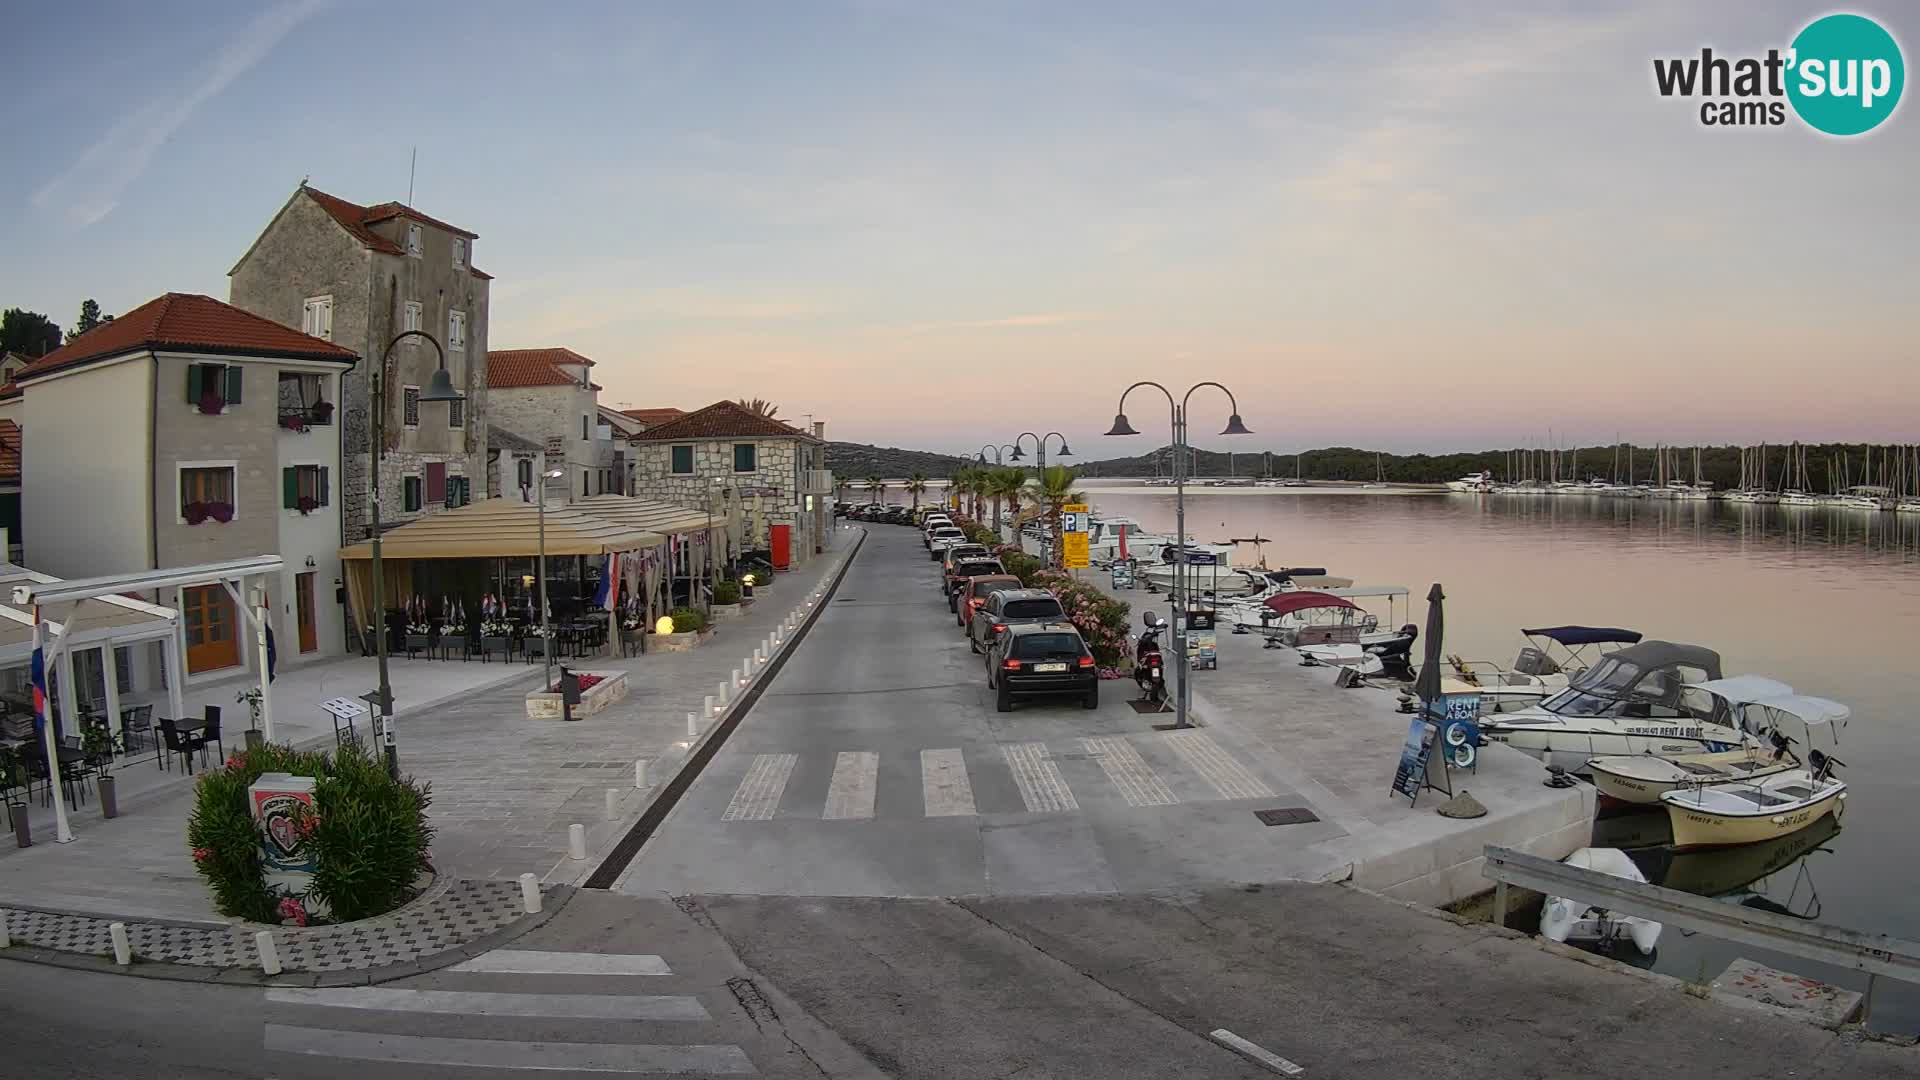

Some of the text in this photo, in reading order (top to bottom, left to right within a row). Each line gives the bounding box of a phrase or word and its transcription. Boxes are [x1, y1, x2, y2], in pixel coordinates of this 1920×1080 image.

[1065, 514, 1076, 531] P
[1446, 699, 1479, 711] RENT
[1446, 710, 1478, 720] A BOAT
[1660, 727, 1679, 736] RENT
[1680, 727, 1685, 736] A
[1686, 727, 1704, 738] BOAT
